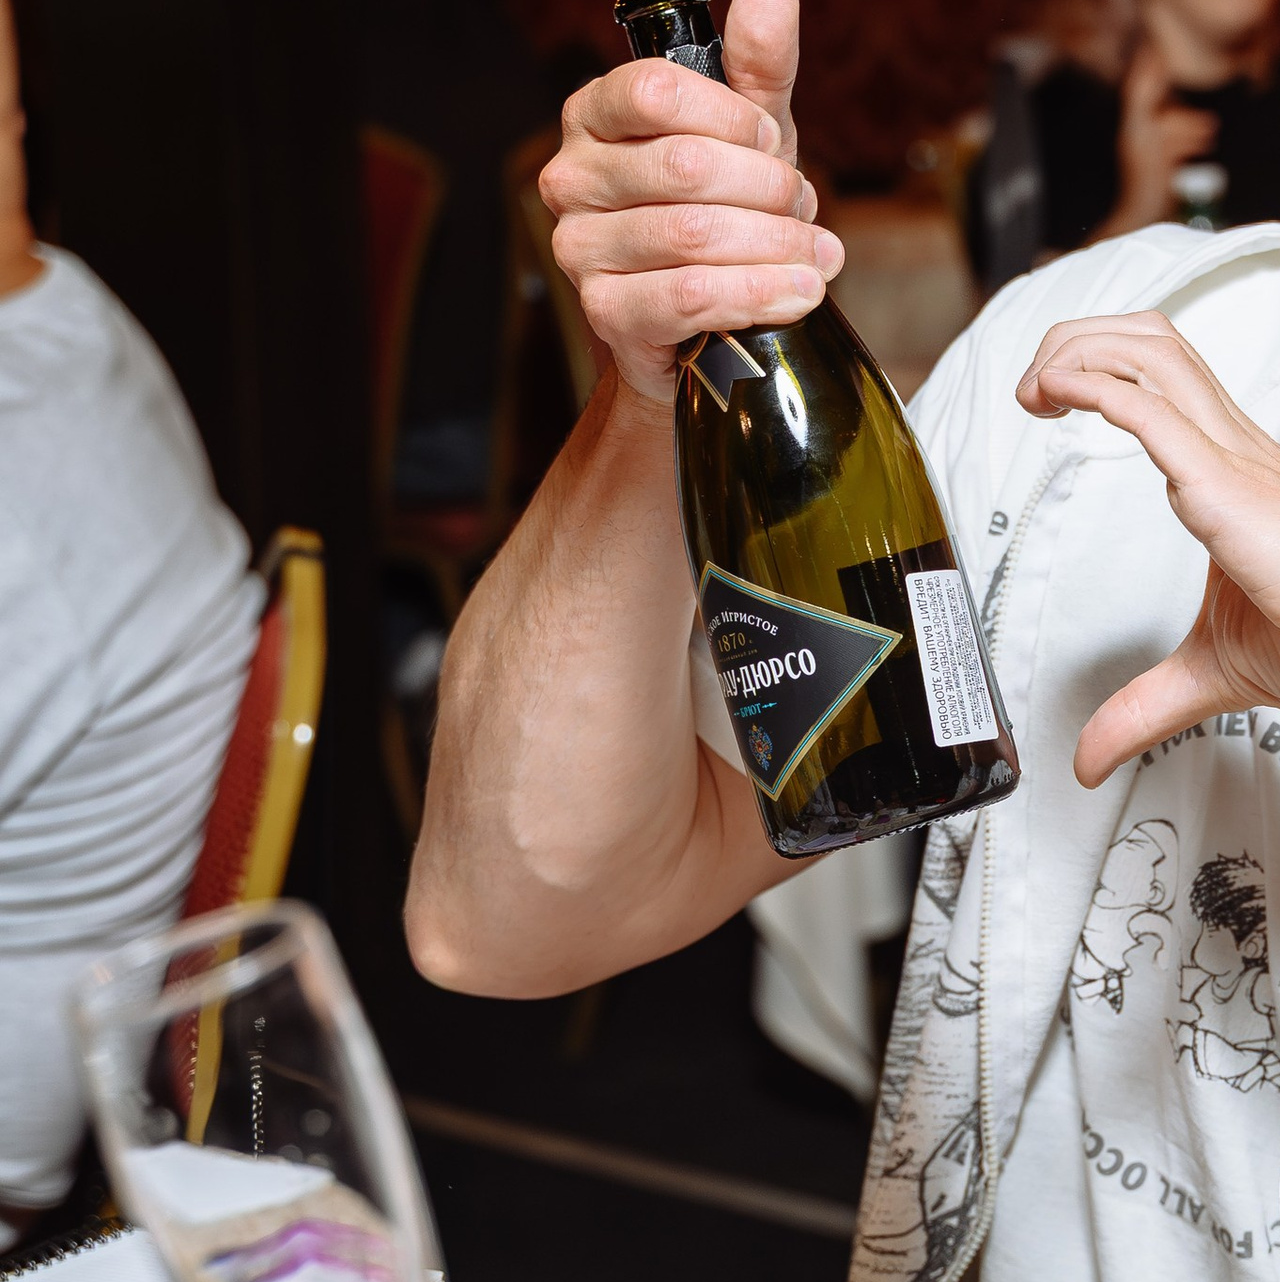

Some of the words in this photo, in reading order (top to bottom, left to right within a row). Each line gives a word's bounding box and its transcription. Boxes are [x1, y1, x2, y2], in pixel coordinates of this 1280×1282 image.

[721, 611, 779, 636] ИГРИСТОЕ
[912, 577, 930, 623] ВРЕДИТ
[717, 631, 746, 653] 1870
[921, 624, 940, 673] ВАШЕМУ
[924, 577, 942, 631] ЧРЕЗМЕРНОЕ
[933, 629, 955, 693] УПОТРЕБЛЕНИЕ
[946, 693, 963, 737] АЛКОГОЛЯ
[739, 702, 761, 718] БРЮТ
[930, 675, 952, 740] ЗДОРОВЬЮ
[1159, 1174, 1206, 1223] ALL
